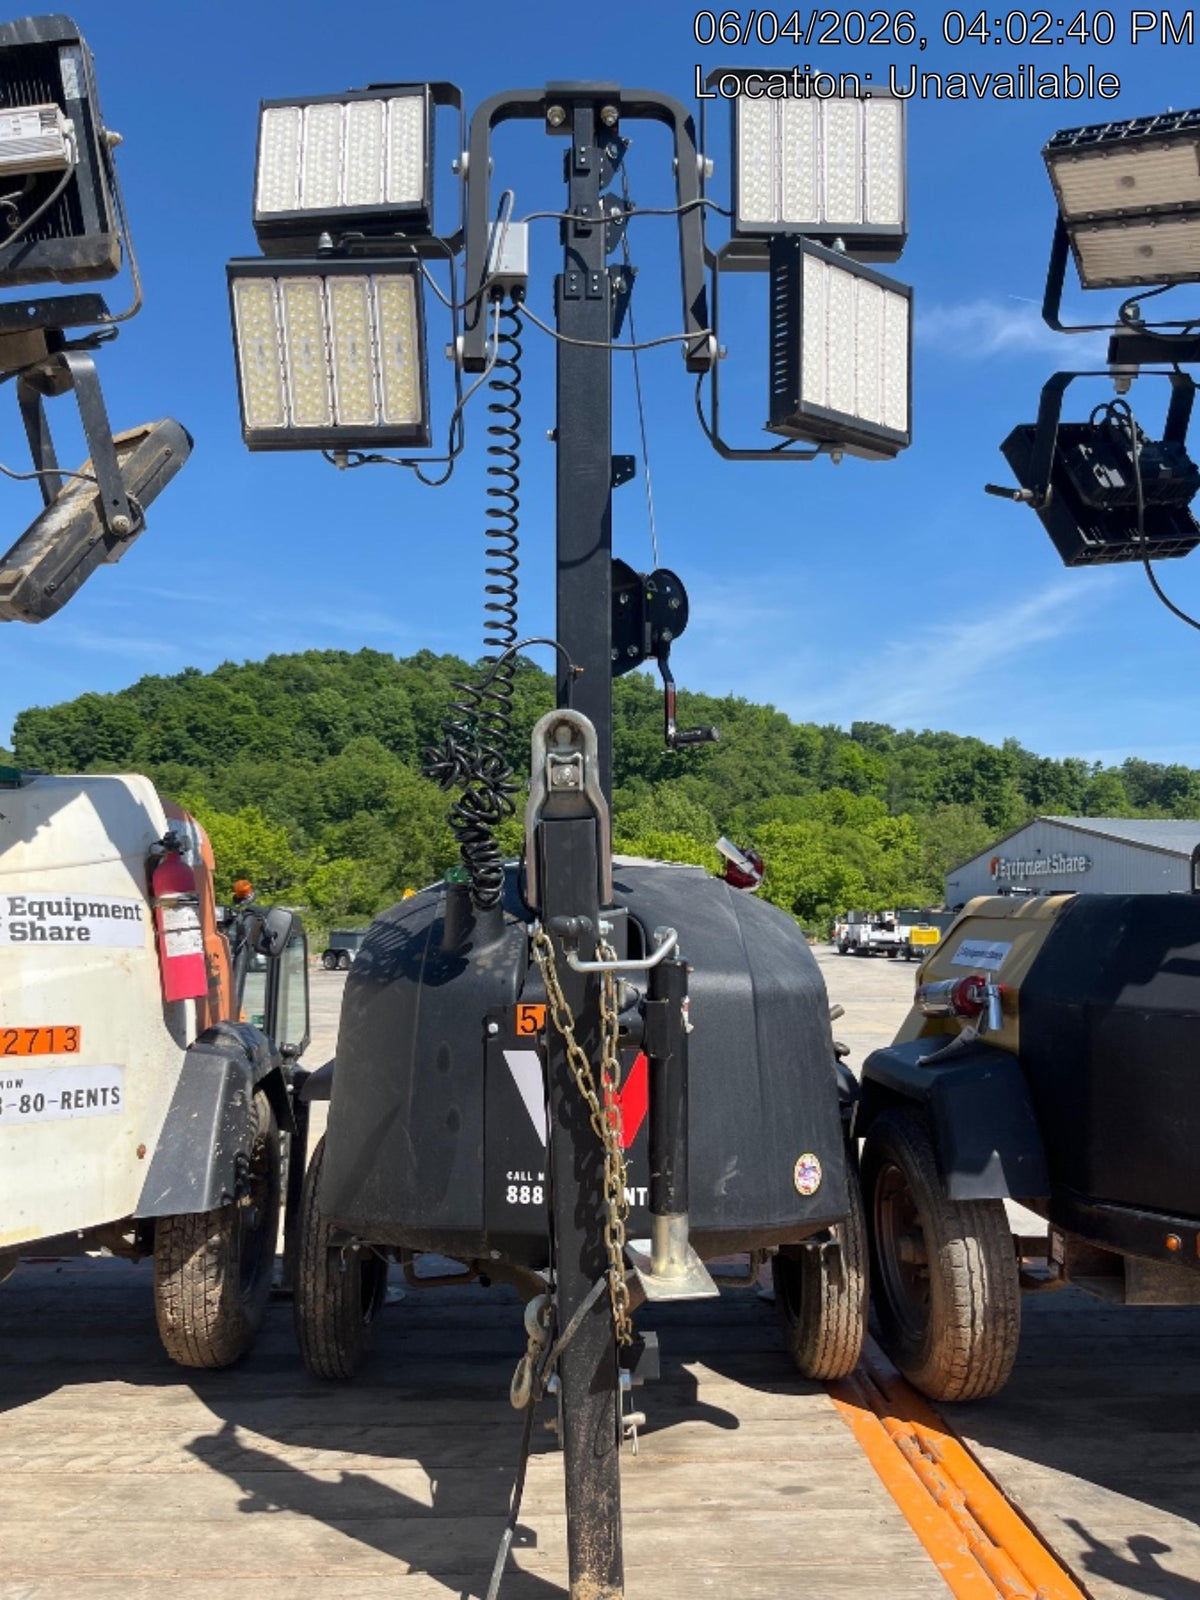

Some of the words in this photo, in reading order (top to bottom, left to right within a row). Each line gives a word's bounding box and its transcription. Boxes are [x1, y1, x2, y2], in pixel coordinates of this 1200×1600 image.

[7, 896, 143, 921] Equipment
[8, 921, 91, 941] Share
[3, 1027, 77, 1055] 2713
[0, 1086, 120, 1115] -80-RENTS
[506, 1171, 533, 1181] CALL
[506, 1185, 543, 1204] 888
